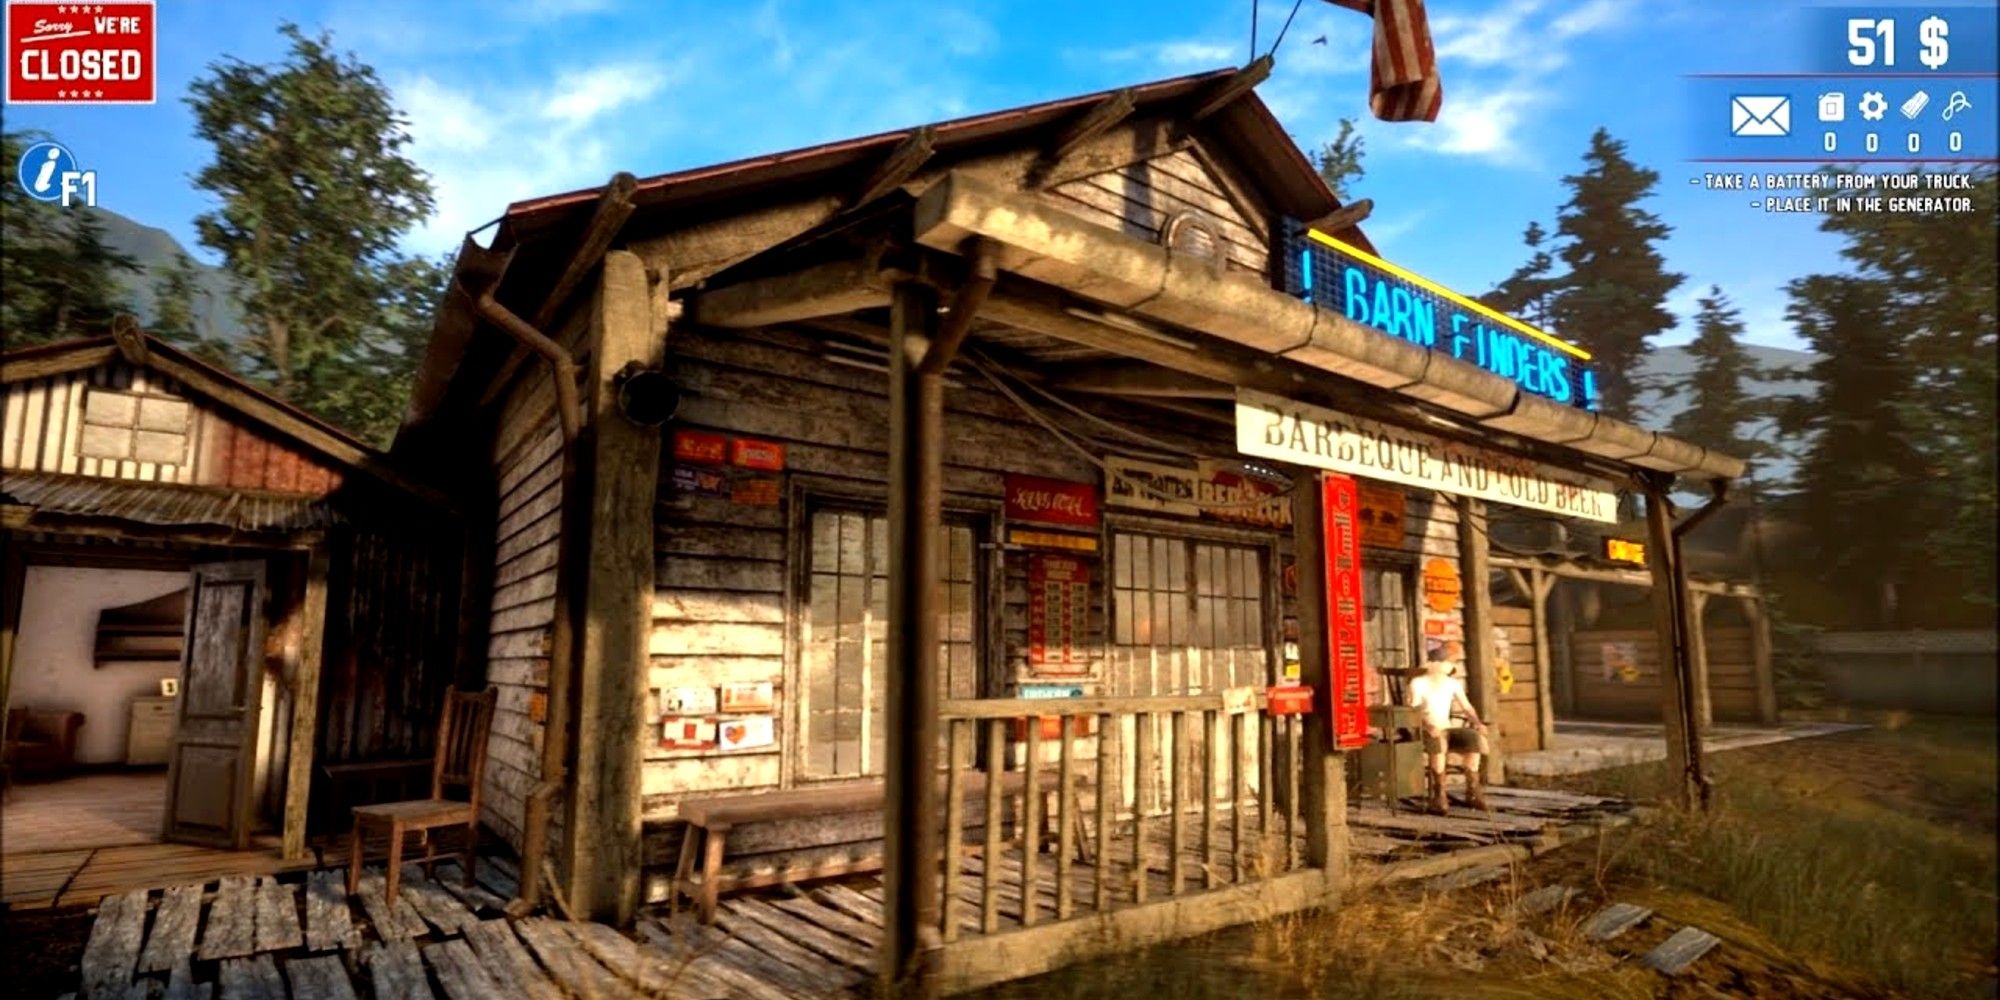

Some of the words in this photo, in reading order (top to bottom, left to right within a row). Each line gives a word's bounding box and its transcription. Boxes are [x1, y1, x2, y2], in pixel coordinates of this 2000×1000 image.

[1343, 267, 1435, 347] BARN
[1451, 311, 1572, 404] FINDERS
[1263, 404, 1433, 480] BARBEQUE
[1440, 450, 1490, 492] AND
[1495, 463, 1550, 505] COLD
[1554, 478, 1603, 518] BEER
